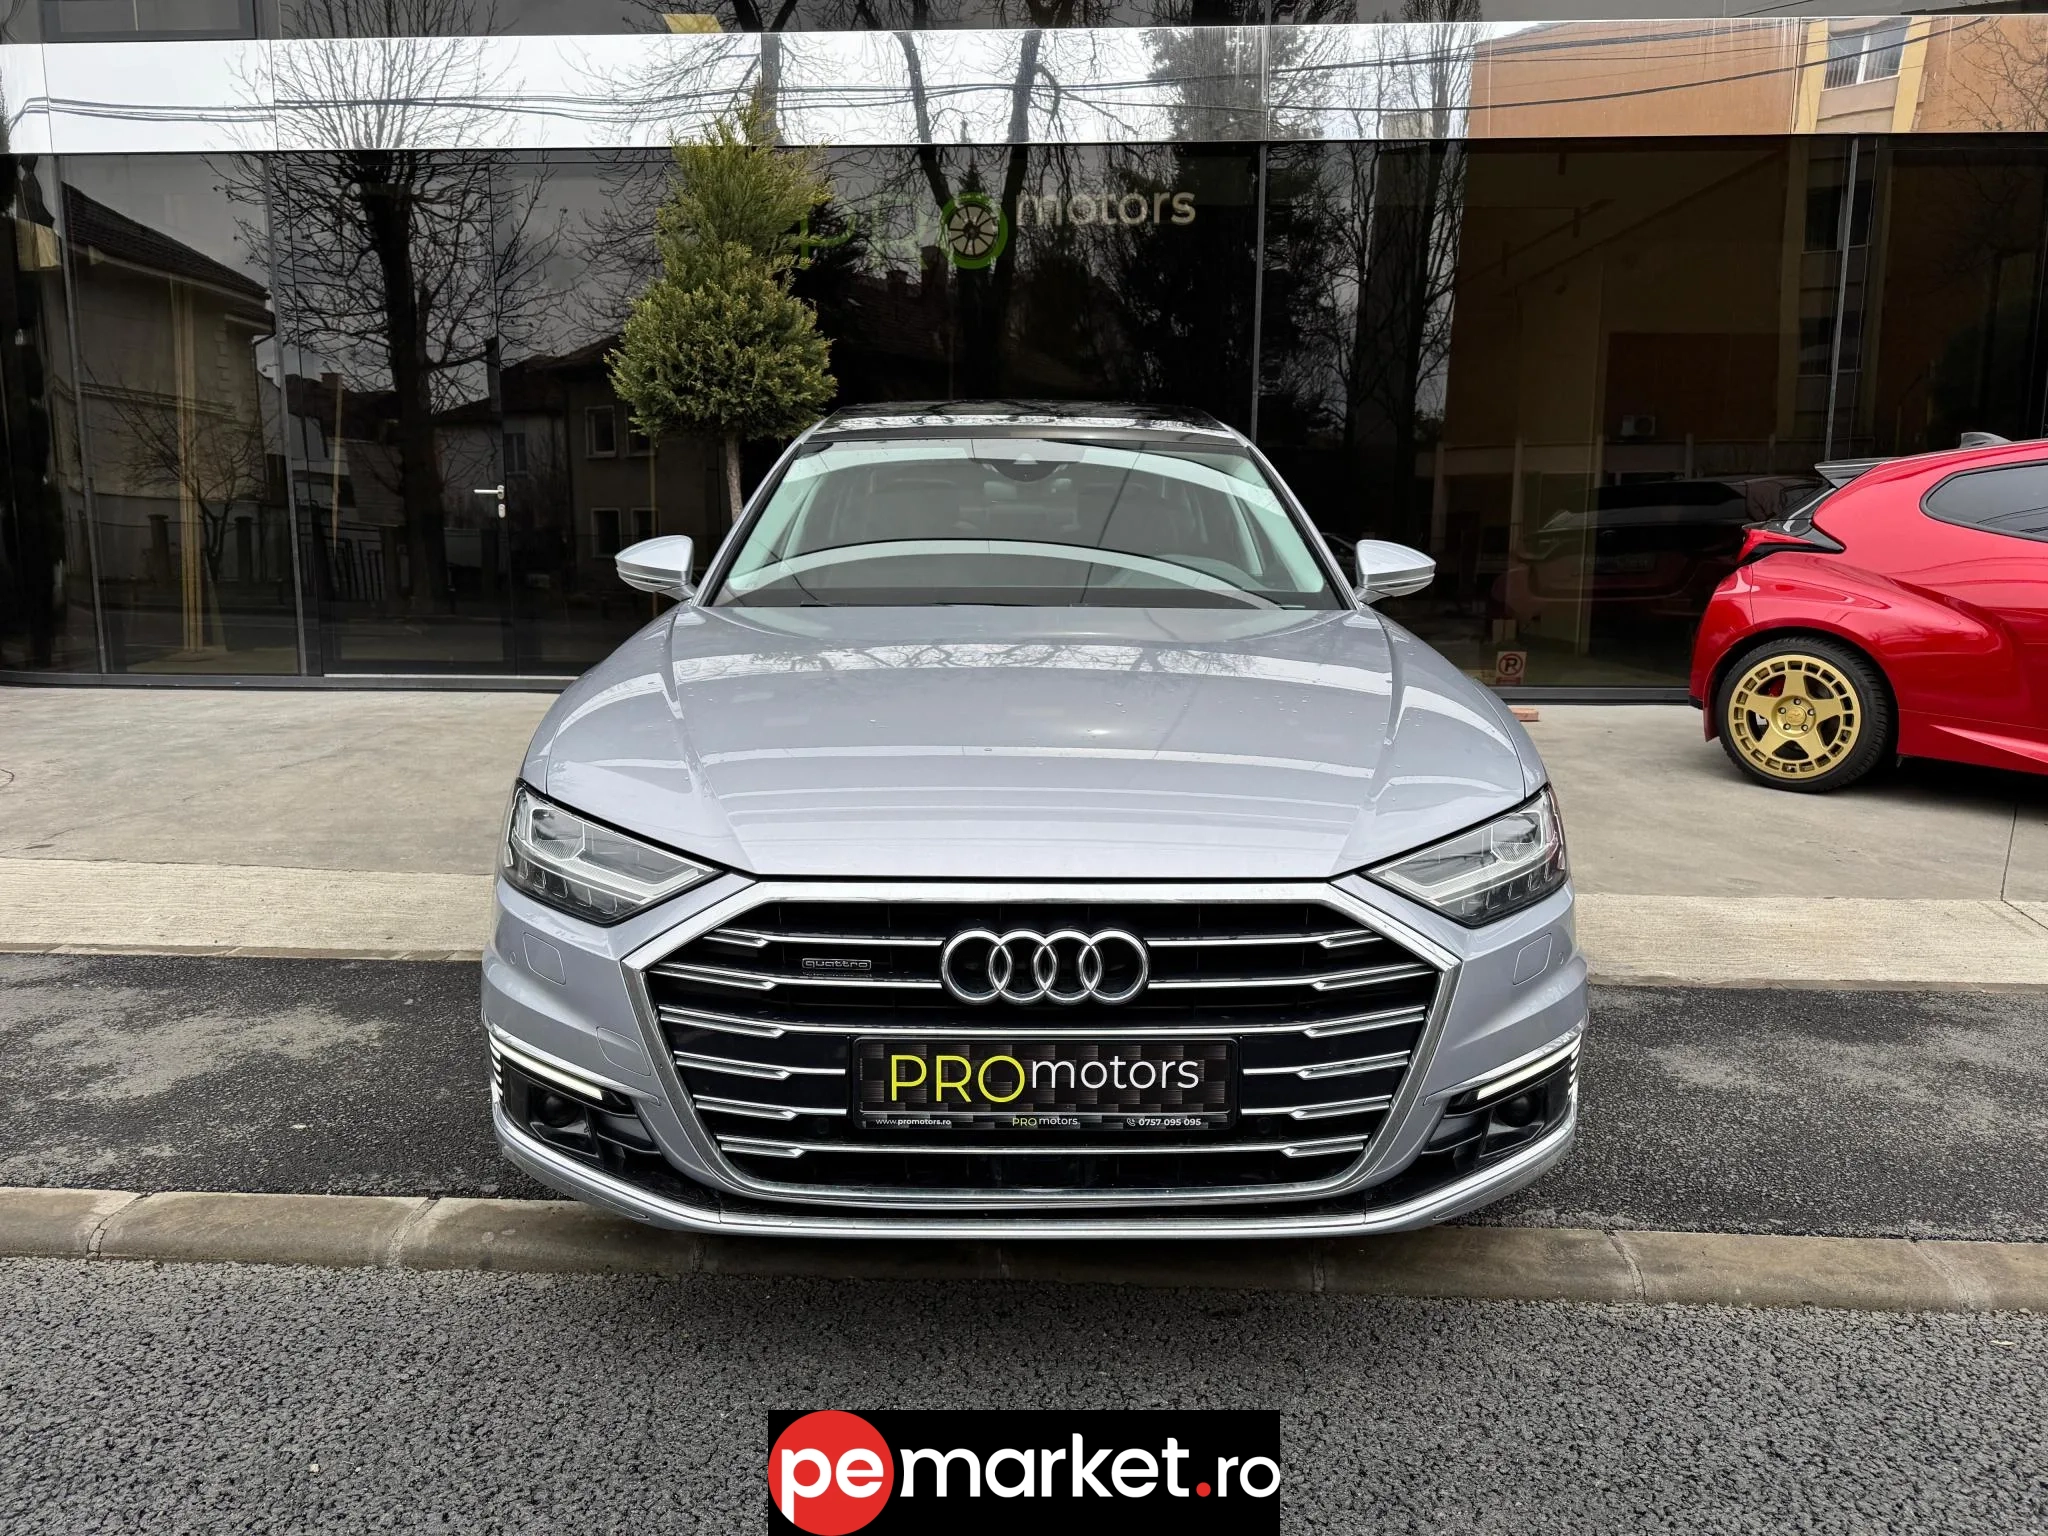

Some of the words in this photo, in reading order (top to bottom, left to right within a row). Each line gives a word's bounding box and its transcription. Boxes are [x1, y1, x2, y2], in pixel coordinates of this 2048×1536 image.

[804, 960, 868, 968] quattro
[875, 1118, 952, 1126] www.promotors.ro
[1138, 1118, 1161, 1126] 0757
[1163, 1118, 1182, 1126] 095
[1183, 1118, 1202, 1126] 095
